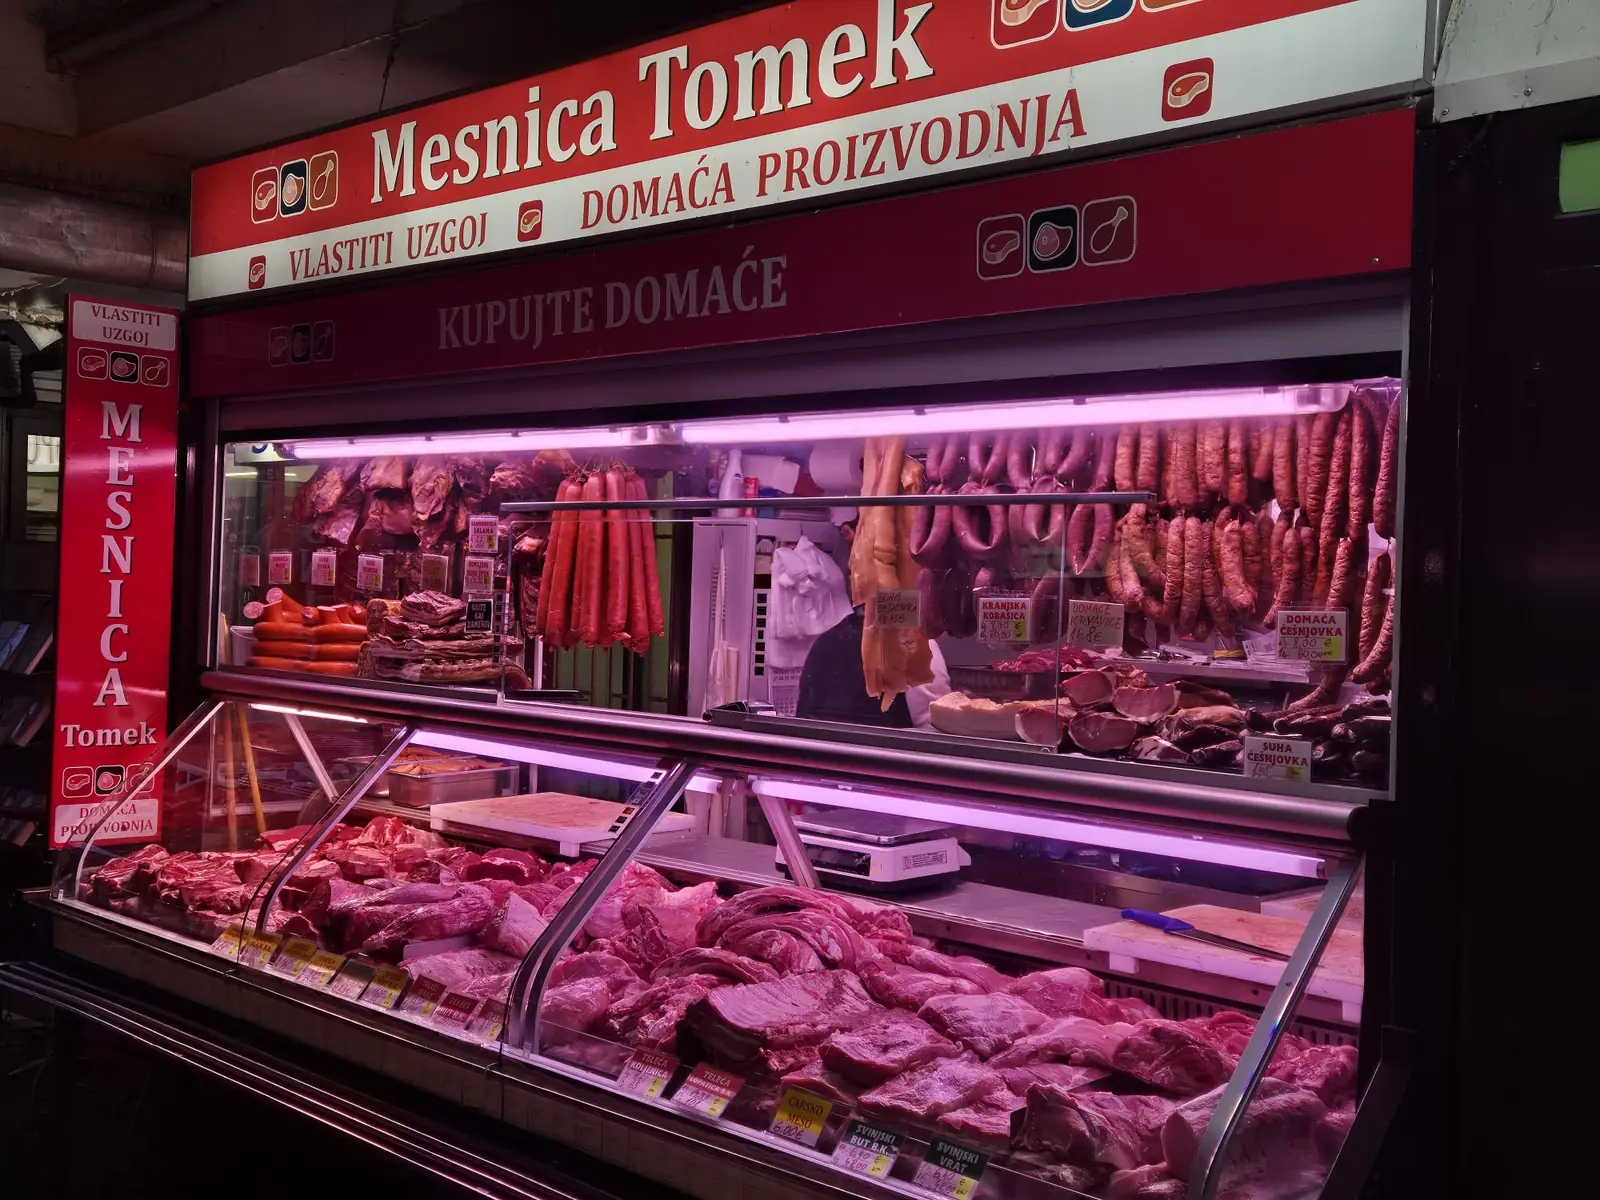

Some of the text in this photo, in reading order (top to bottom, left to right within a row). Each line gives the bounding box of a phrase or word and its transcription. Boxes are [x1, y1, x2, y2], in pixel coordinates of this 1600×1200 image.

[371, 0, 935, 204] Mesnica Tomek
[581, 88, 1087, 230] DOMAĆA PROIZVODNJA
[289, 212, 488, 281] VLASTITI UZGOJ
[438, 246, 788, 350] KUPUJTE DOMAĆE
[91, 305, 161, 327] VLASTITI
[102, 326, 149, 347] UZGOJ
[93, 401, 143, 707] MESNICA
[982, 601, 1027, 611] KRANJSKA
[1286, 613, 1337, 624] DOMAĆA
[1280, 624, 1343, 638] ČEŠNJOVKA
[61, 721, 157, 747] Tomek
[1263, 742, 1293, 754] SUHA
[61, 819, 153, 837] PROIVODNJA
[630, 1061, 669, 1079] KOLJENICA
[788, 1096, 824, 1117] CARSKO
[786, 1112, 813, 1129] MESO
[855, 1124, 896, 1145] SVINJSKI
[850, 1135, 871, 1148] BUT
[871, 1142, 889, 1156] B.K.
[936, 1141, 980, 1165] SVINJSKI
[939, 1156, 968, 1174] VRAT
